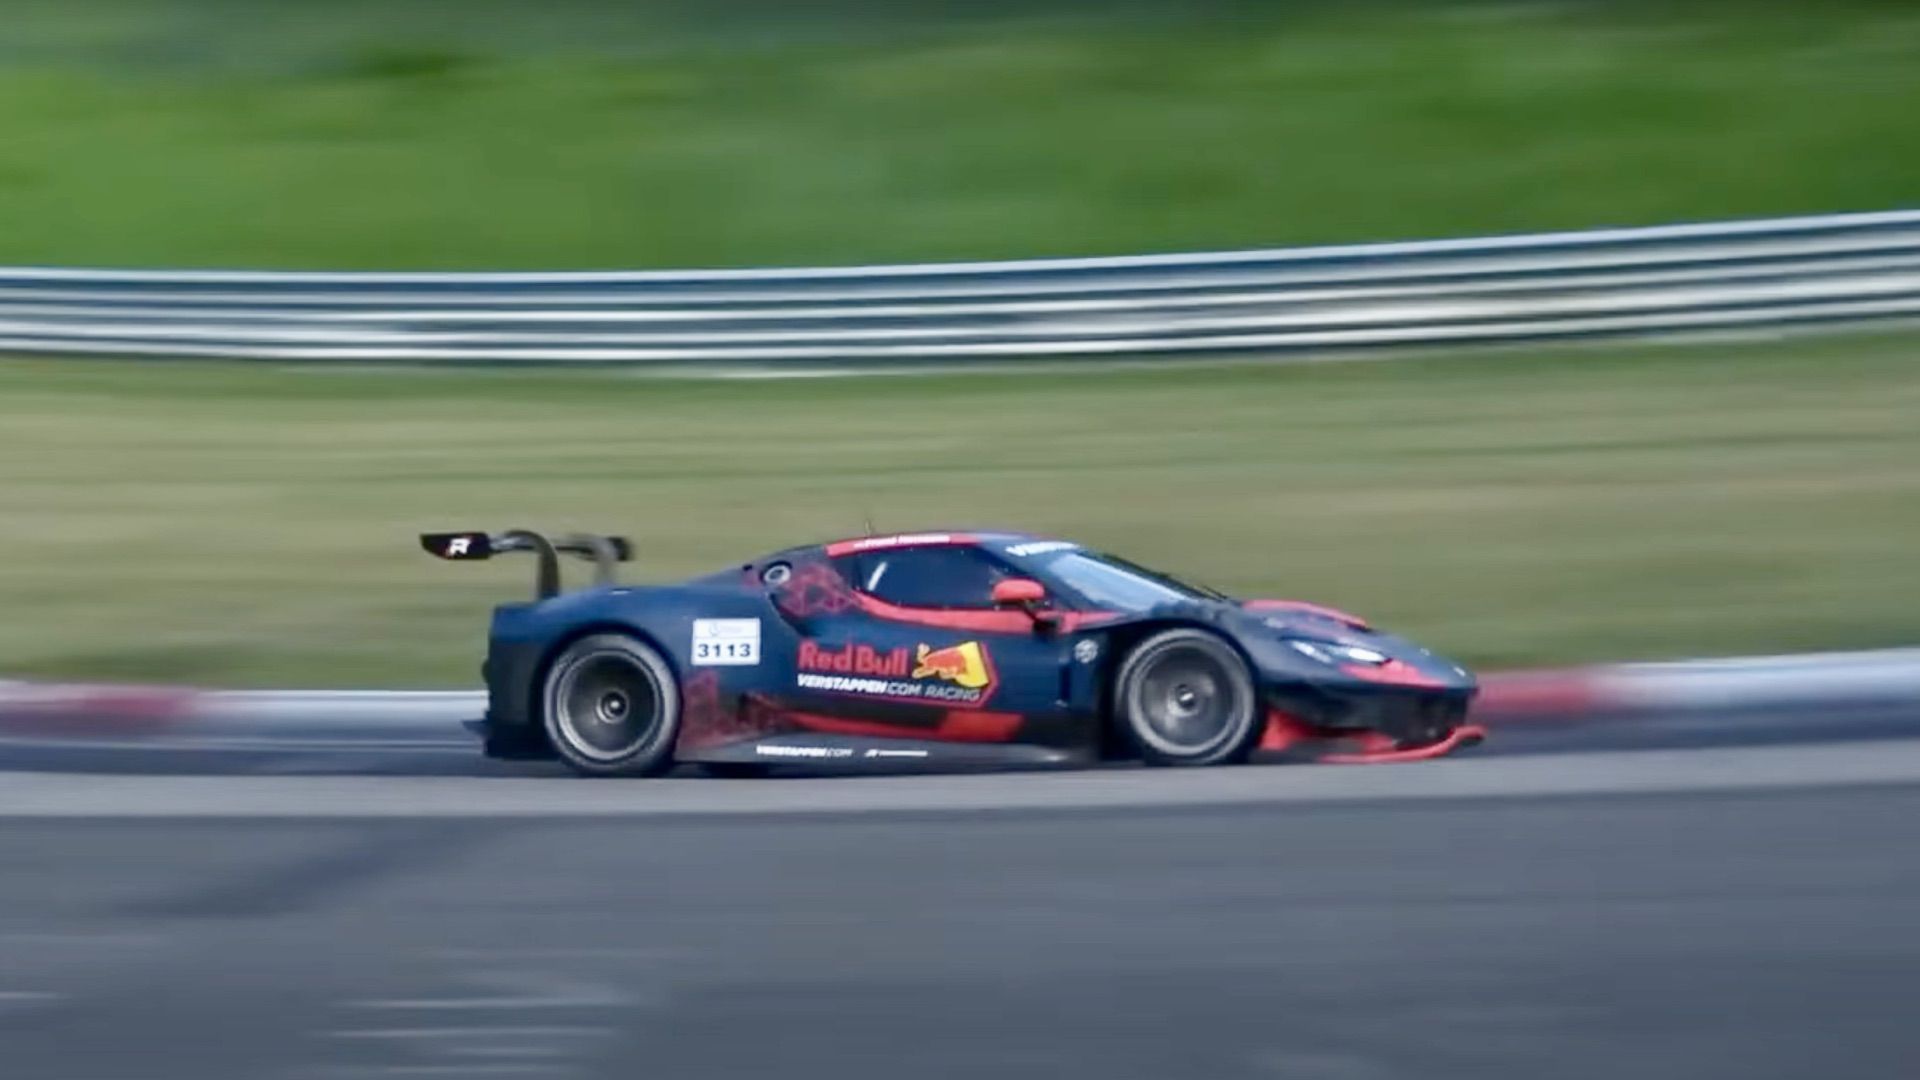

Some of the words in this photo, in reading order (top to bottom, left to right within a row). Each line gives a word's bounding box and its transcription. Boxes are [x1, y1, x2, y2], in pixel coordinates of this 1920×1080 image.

[698, 643, 750, 658] 3113
[798, 639, 852, 671] Red
[855, 644, 908, 677] Bull
[797, 673, 921, 696] VERSTAPPEN.COM
[924, 685, 980, 701] RACING
